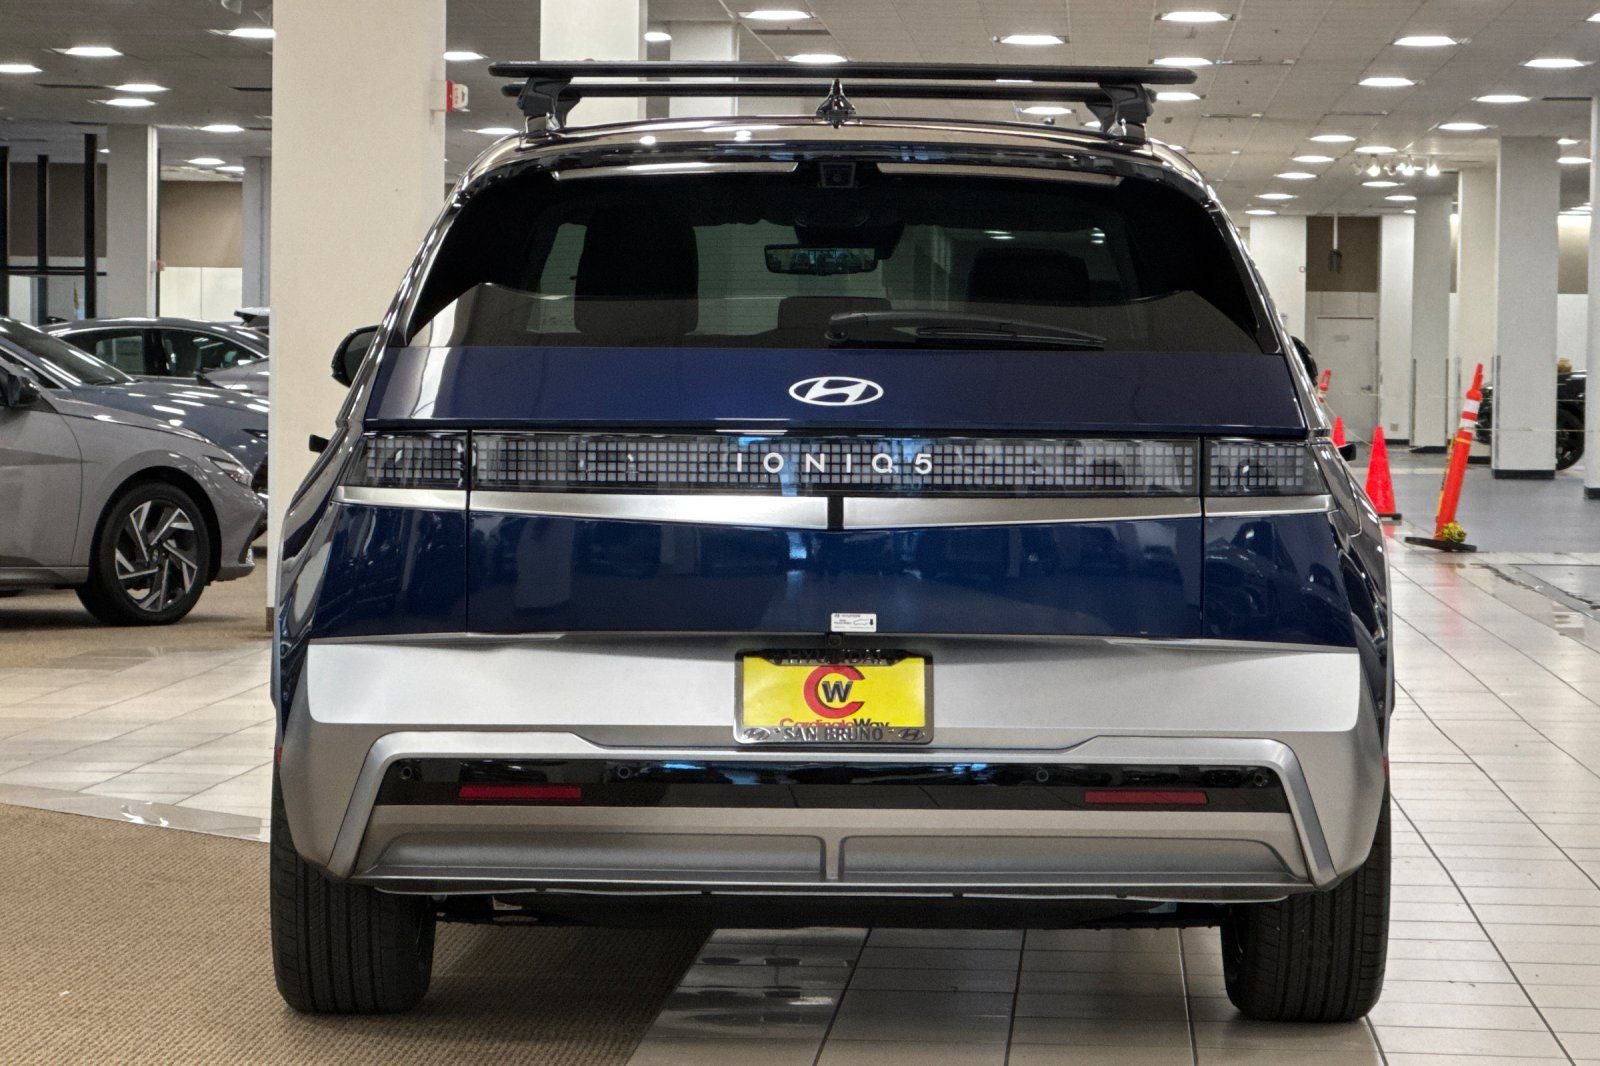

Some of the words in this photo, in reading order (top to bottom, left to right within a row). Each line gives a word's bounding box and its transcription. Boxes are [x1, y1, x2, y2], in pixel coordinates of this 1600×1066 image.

[737, 452, 893, 474] IONIQ
[914, 453, 933, 475] 5
[783, 727, 819, 741] SAN
[824, 727, 884, 741] BRUNO
